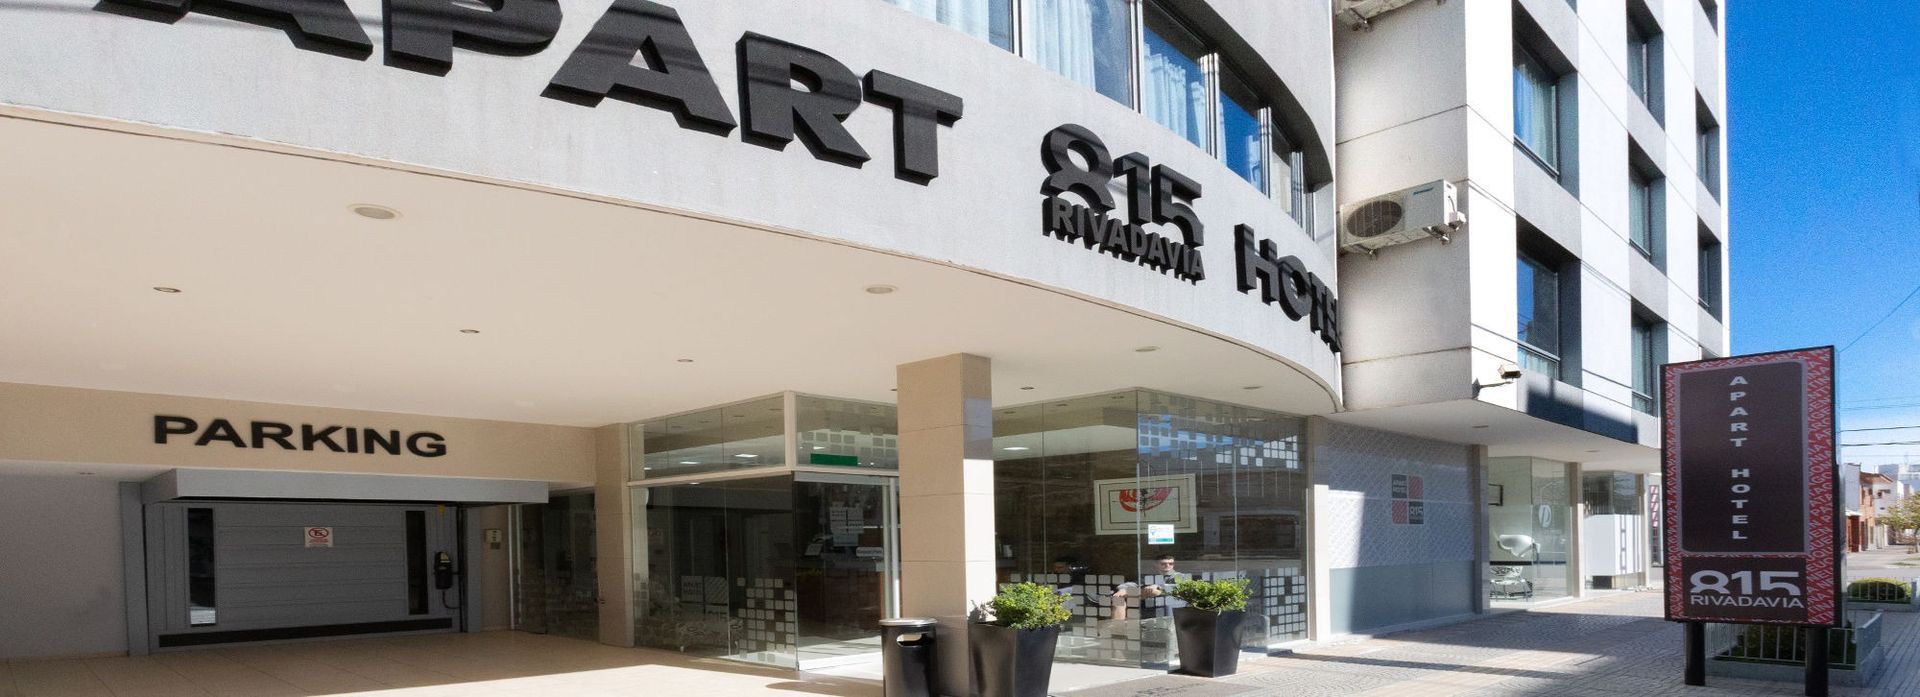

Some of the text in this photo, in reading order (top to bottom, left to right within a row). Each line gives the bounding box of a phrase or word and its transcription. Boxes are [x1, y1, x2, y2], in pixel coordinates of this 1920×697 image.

[1040, 123, 1205, 247] 815
[1042, 196, 1206, 287] RIVADAVIA
[154, 415, 447, 458] PARKING
[1729, 375, 1751, 540] APART HOTEL
[1690, 569, 1801, 596] 815
[1690, 594, 1805, 609] RIVADAVIA
